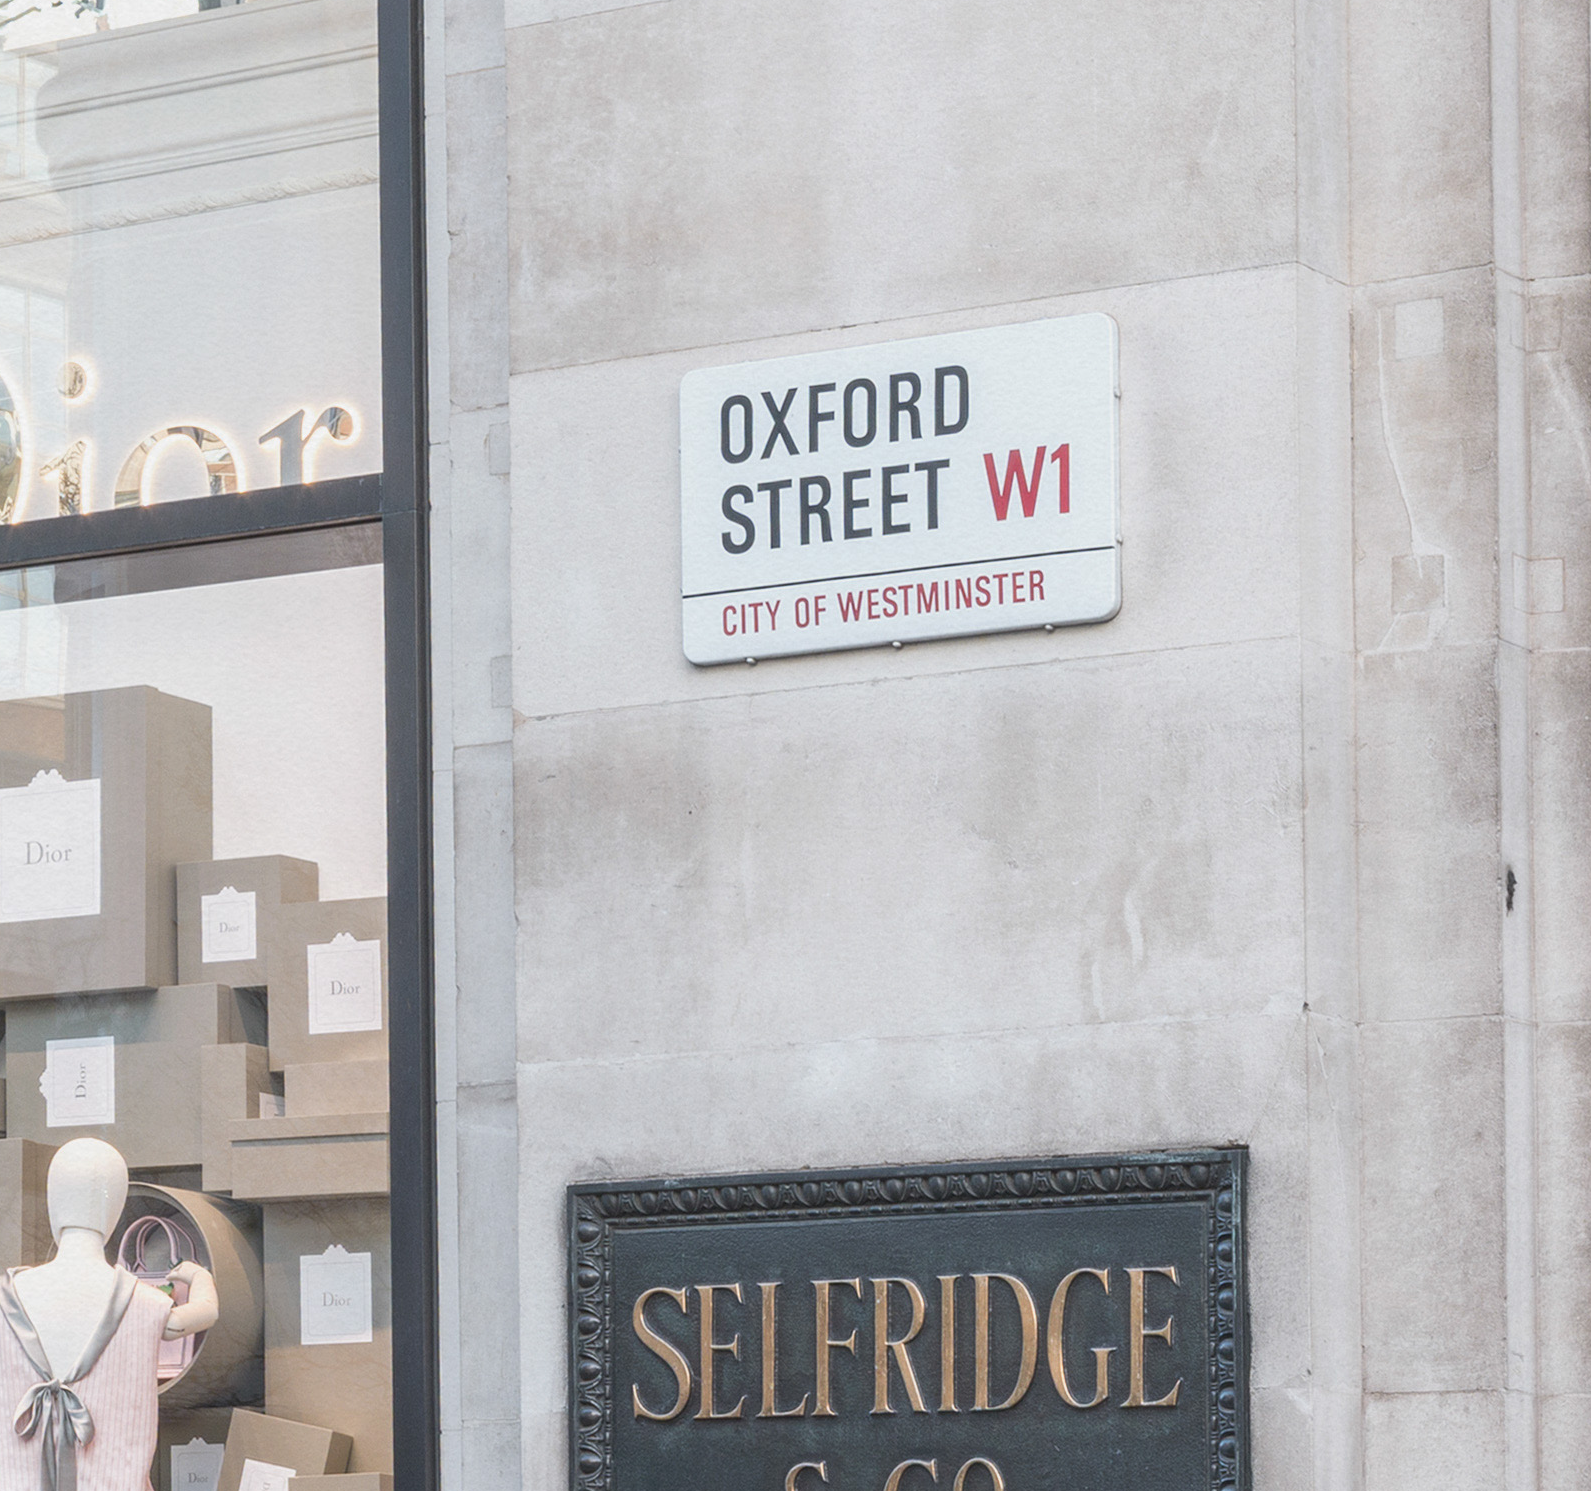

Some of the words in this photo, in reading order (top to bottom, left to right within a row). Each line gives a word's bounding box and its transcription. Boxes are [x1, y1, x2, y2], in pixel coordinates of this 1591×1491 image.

[720, 365, 970, 464] OXFORD
[721, 459, 950, 554] STREET
[983, 443, 1071, 521] W1
[723, 599, 781, 636] CITY
[795, 594, 826, 628] OF
[837, 569, 1046, 622] WESTMINSTER
[24, 840, 72, 866] Dior
[219, 921, 240, 933] Dior
[330, 979, 361, 995] Dior
[74, 1063, 86, 1099] Dior
[322, 1291, 352, 1307] Dior
[631, 1266, 1183, 1421] SELFRIDGE
[188, 1471, 209, 1484] Dior
